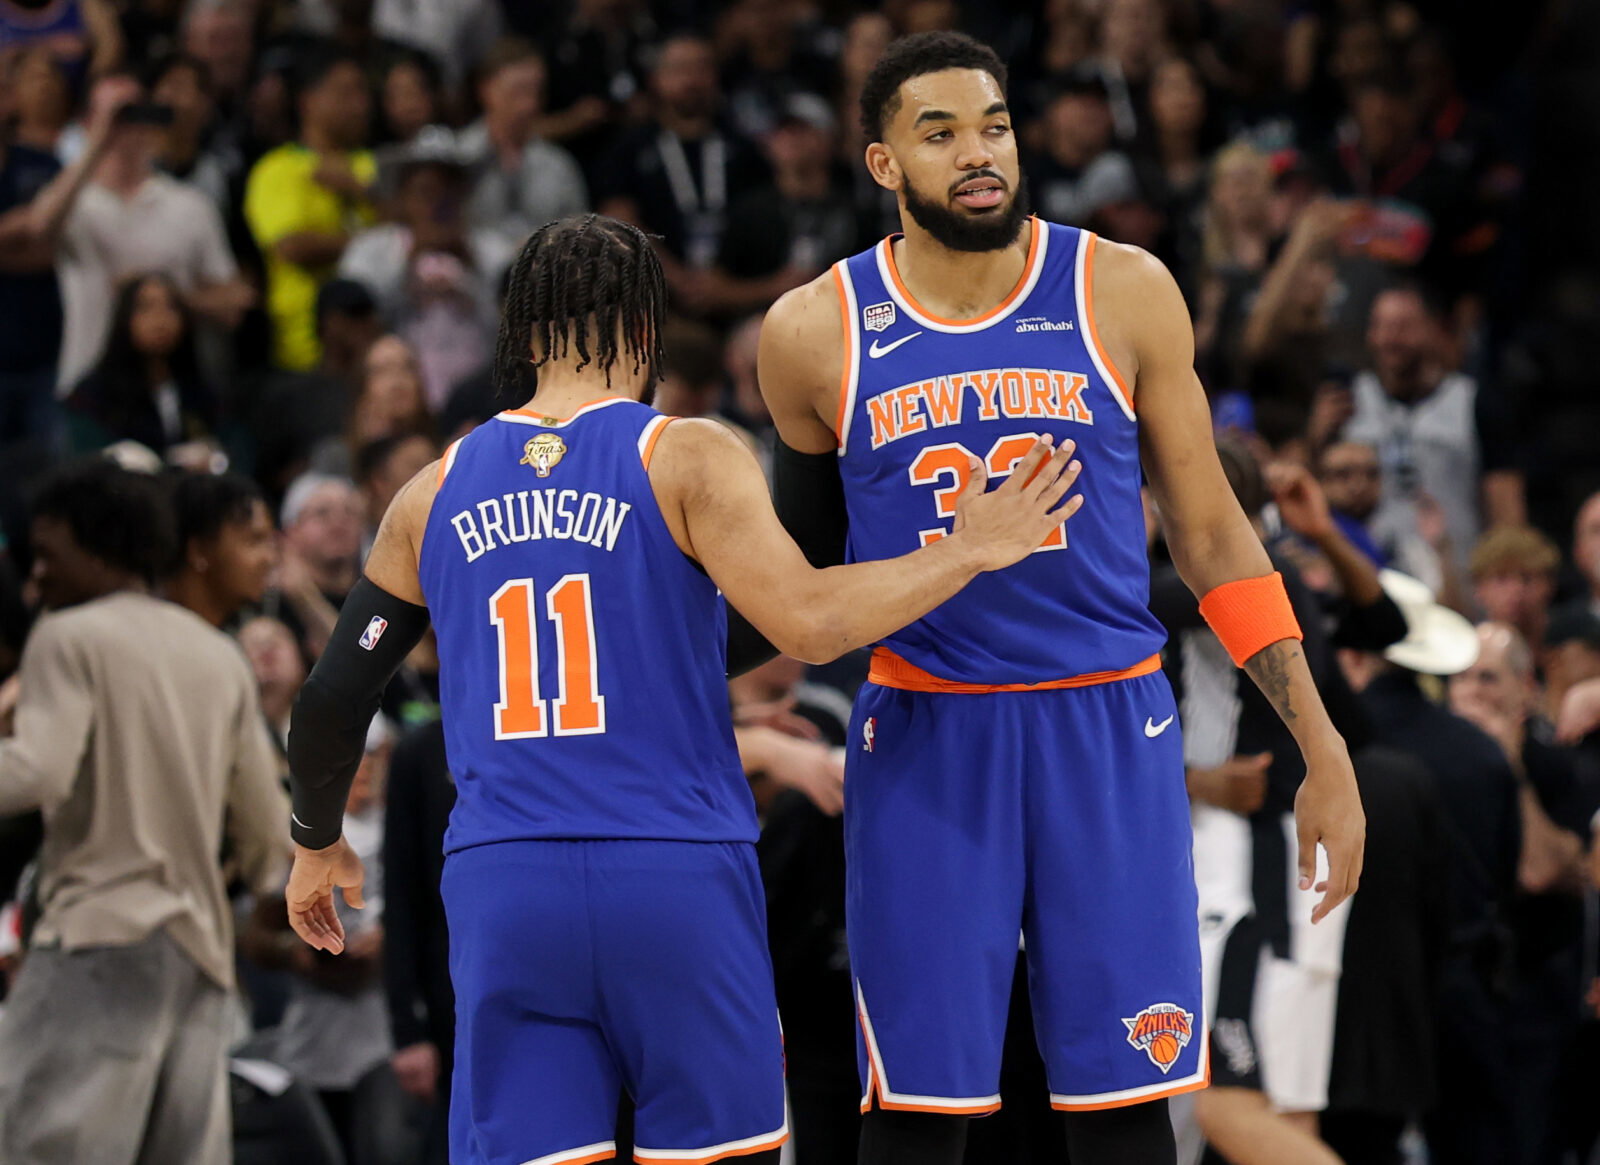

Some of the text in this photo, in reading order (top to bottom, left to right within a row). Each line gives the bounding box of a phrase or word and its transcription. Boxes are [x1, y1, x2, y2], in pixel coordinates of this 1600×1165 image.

[1015, 320, 1074, 333] abu dhabi
[866, 368, 1094, 450] NEW YORK
[450, 488, 632, 563] BRUNSON
[488, 572, 606, 741] 11
[1131, 1011, 1190, 1040] KNICKS
